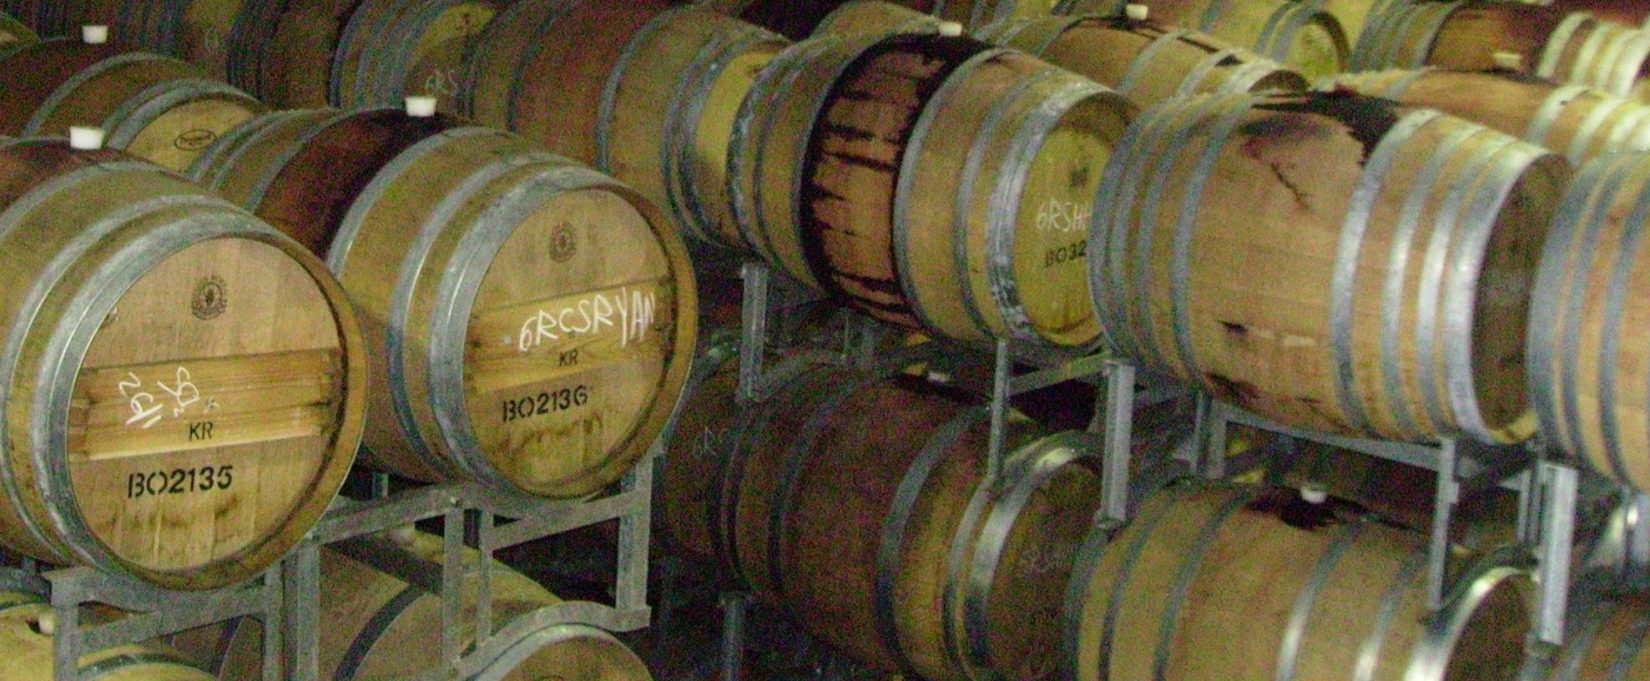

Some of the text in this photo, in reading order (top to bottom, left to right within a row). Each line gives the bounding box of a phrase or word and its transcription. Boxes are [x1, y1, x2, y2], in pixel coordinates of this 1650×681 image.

[559, 349, 578, 367] KR
[502, 384, 589, 423] BO2136
[188, 420, 214, 441] KR
[127, 464, 234, 498] BO2135
